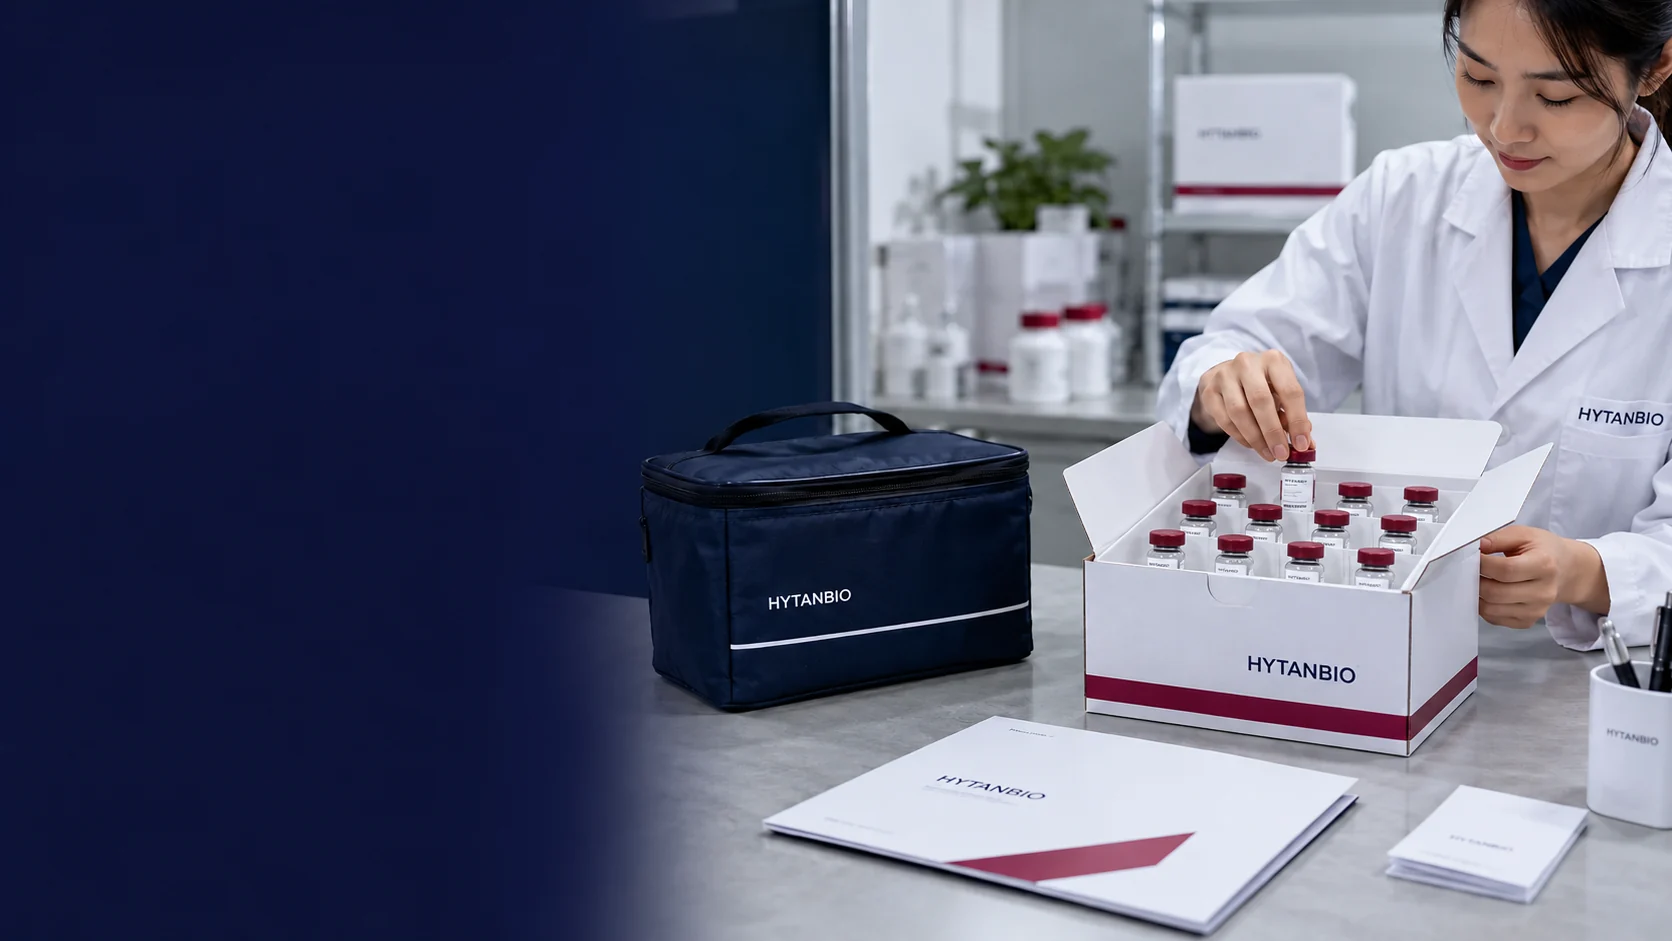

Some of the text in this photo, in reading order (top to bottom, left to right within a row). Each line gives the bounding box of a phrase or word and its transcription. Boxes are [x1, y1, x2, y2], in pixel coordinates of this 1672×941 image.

[1578, 407, 1664, 426] HYTANBIO
[768, 588, 852, 610] HYTANBIO
[1247, 655, 1356, 684] HYTANBIO
[1606, 727, 1659, 746] HYTANBIO
[936, 775, 1046, 800] HYTANBIO
